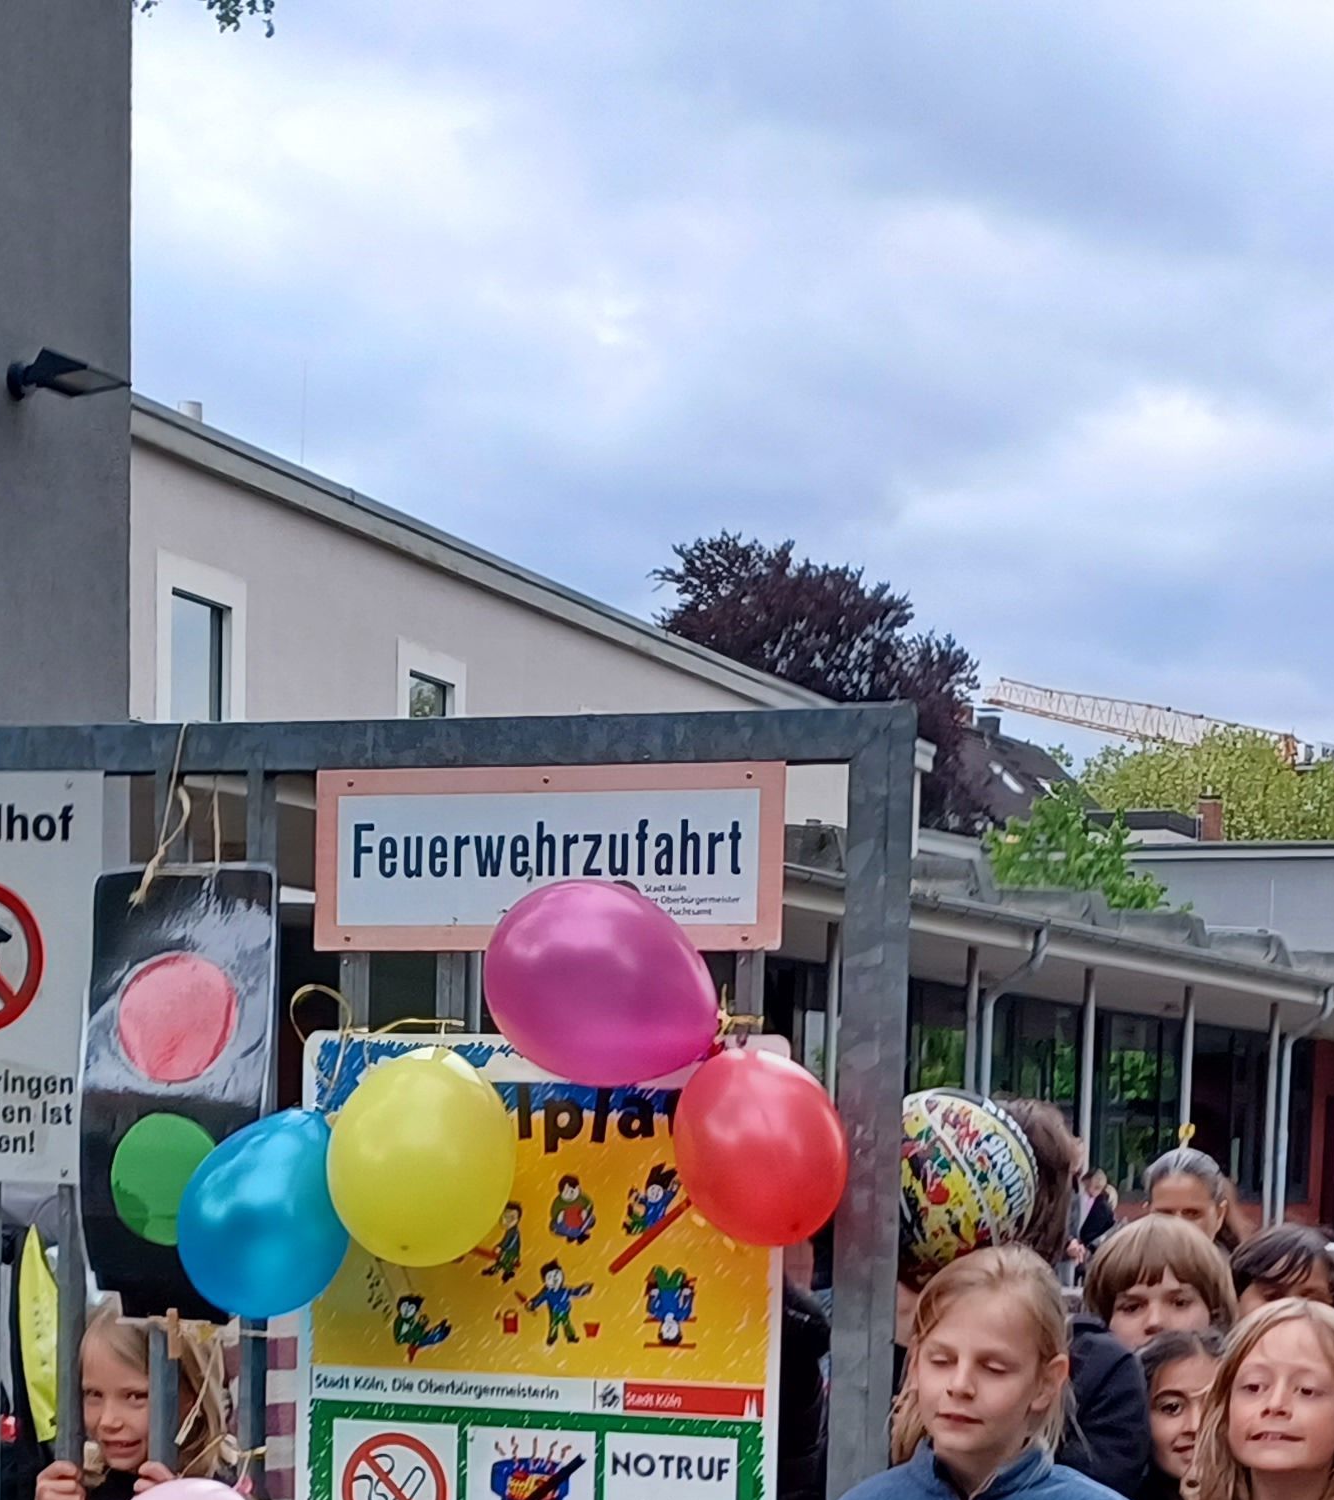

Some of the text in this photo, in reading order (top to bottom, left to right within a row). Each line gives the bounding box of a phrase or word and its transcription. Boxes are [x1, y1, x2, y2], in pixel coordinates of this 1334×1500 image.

[352, 818, 743, 879] Feuerwehrzufahrt
[41, 1101, 74, 1126] ist
[315, 1373, 350, 1390] Stadt
[391, 1376, 414, 1392] Die
[417, 1376, 560, 1401] Oberbürgermeisterin
[611, 1451, 731, 1482] NOTRUF
